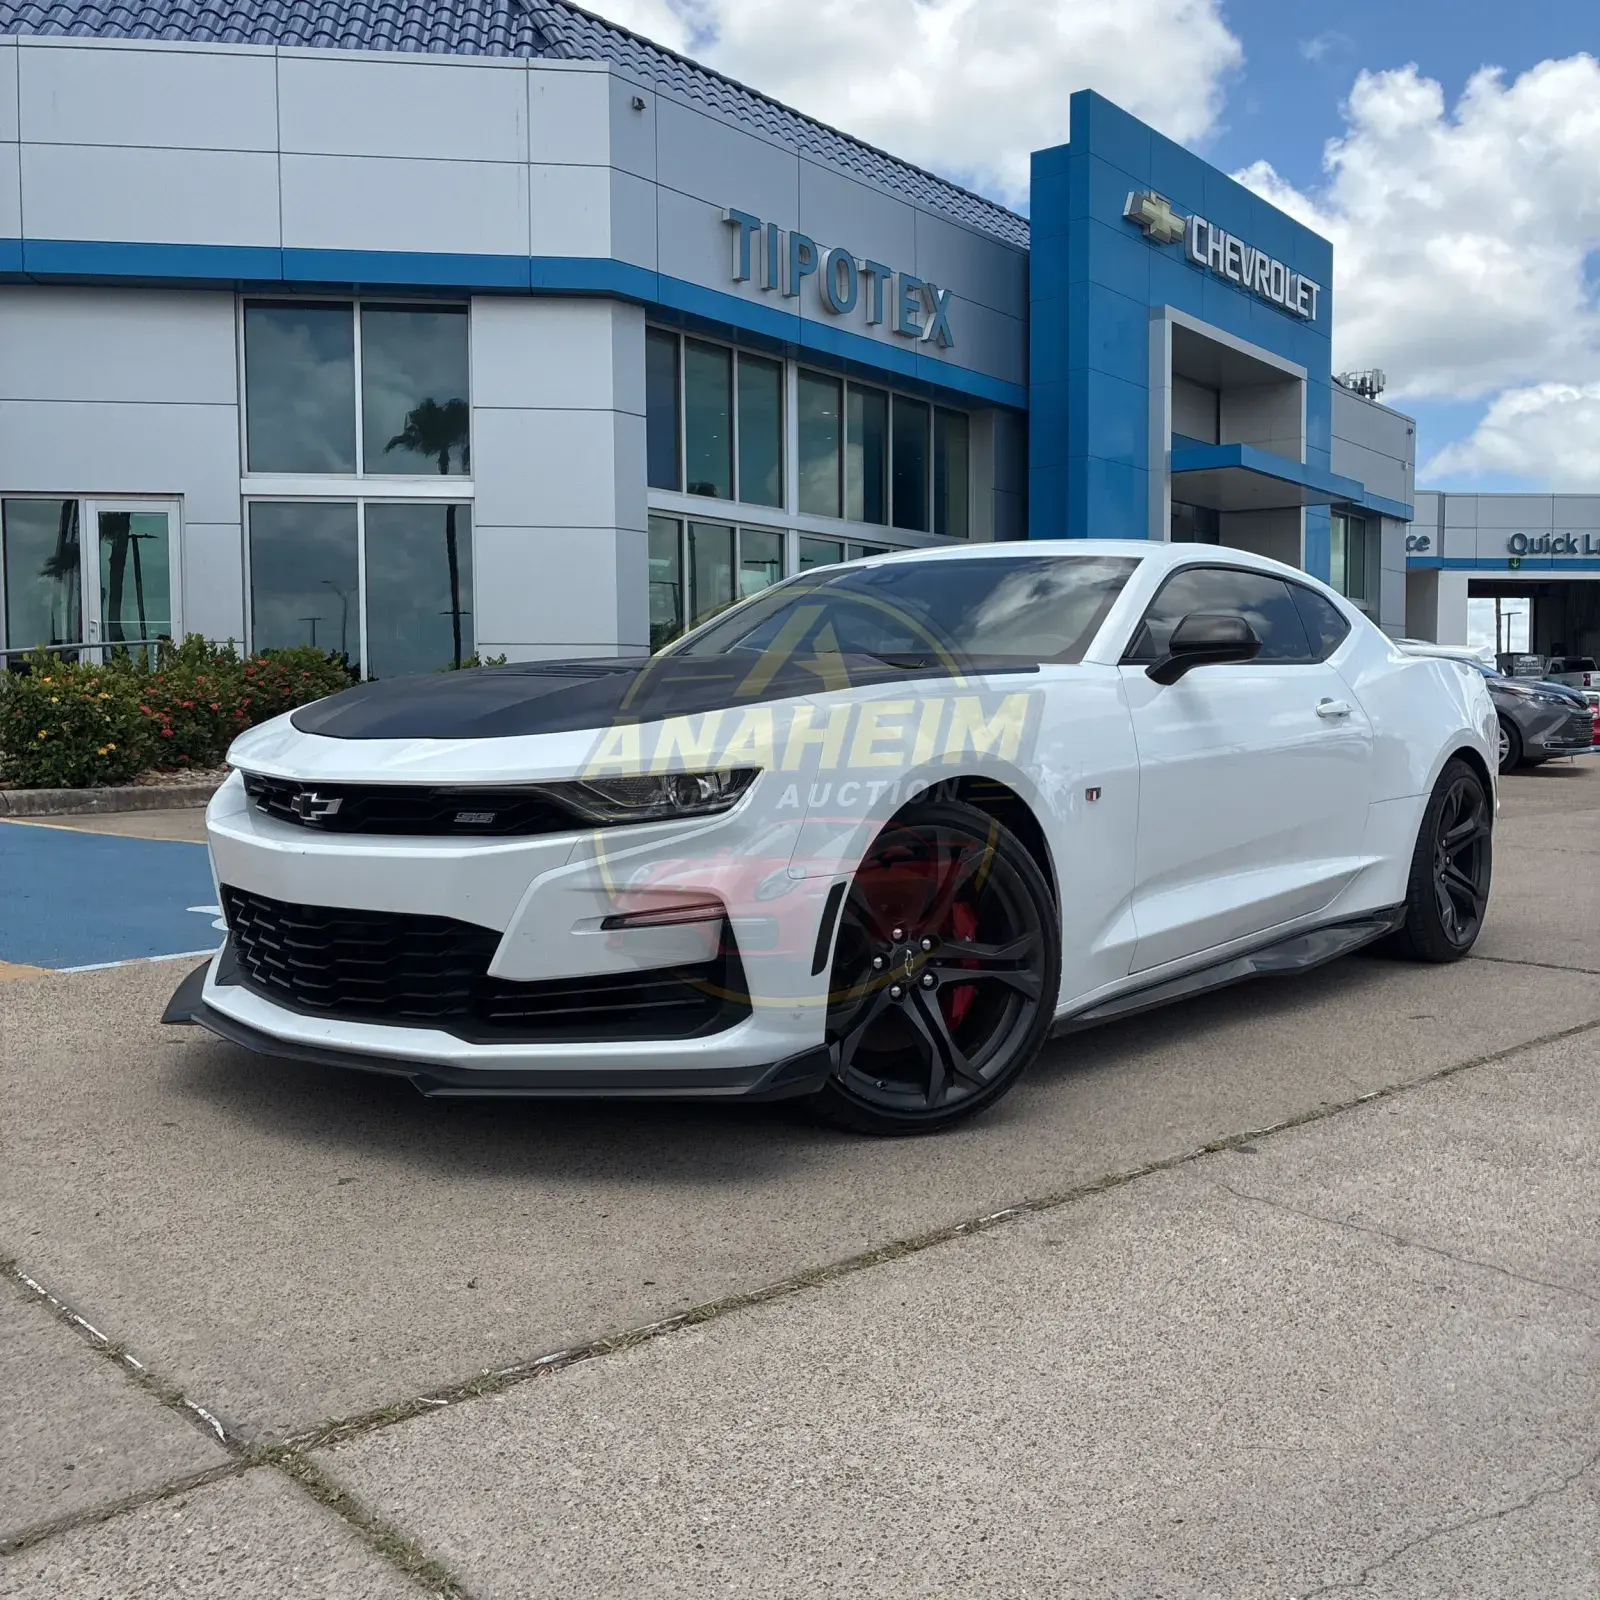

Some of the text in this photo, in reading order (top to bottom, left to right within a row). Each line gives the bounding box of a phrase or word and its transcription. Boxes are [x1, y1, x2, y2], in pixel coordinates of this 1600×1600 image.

[722, 208, 955, 348] TIPOTEX
[1187, 214, 1321, 322] CHEVROLET
[1507, 532, 1579, 556] Quick
[453, 811, 497, 824] SS
